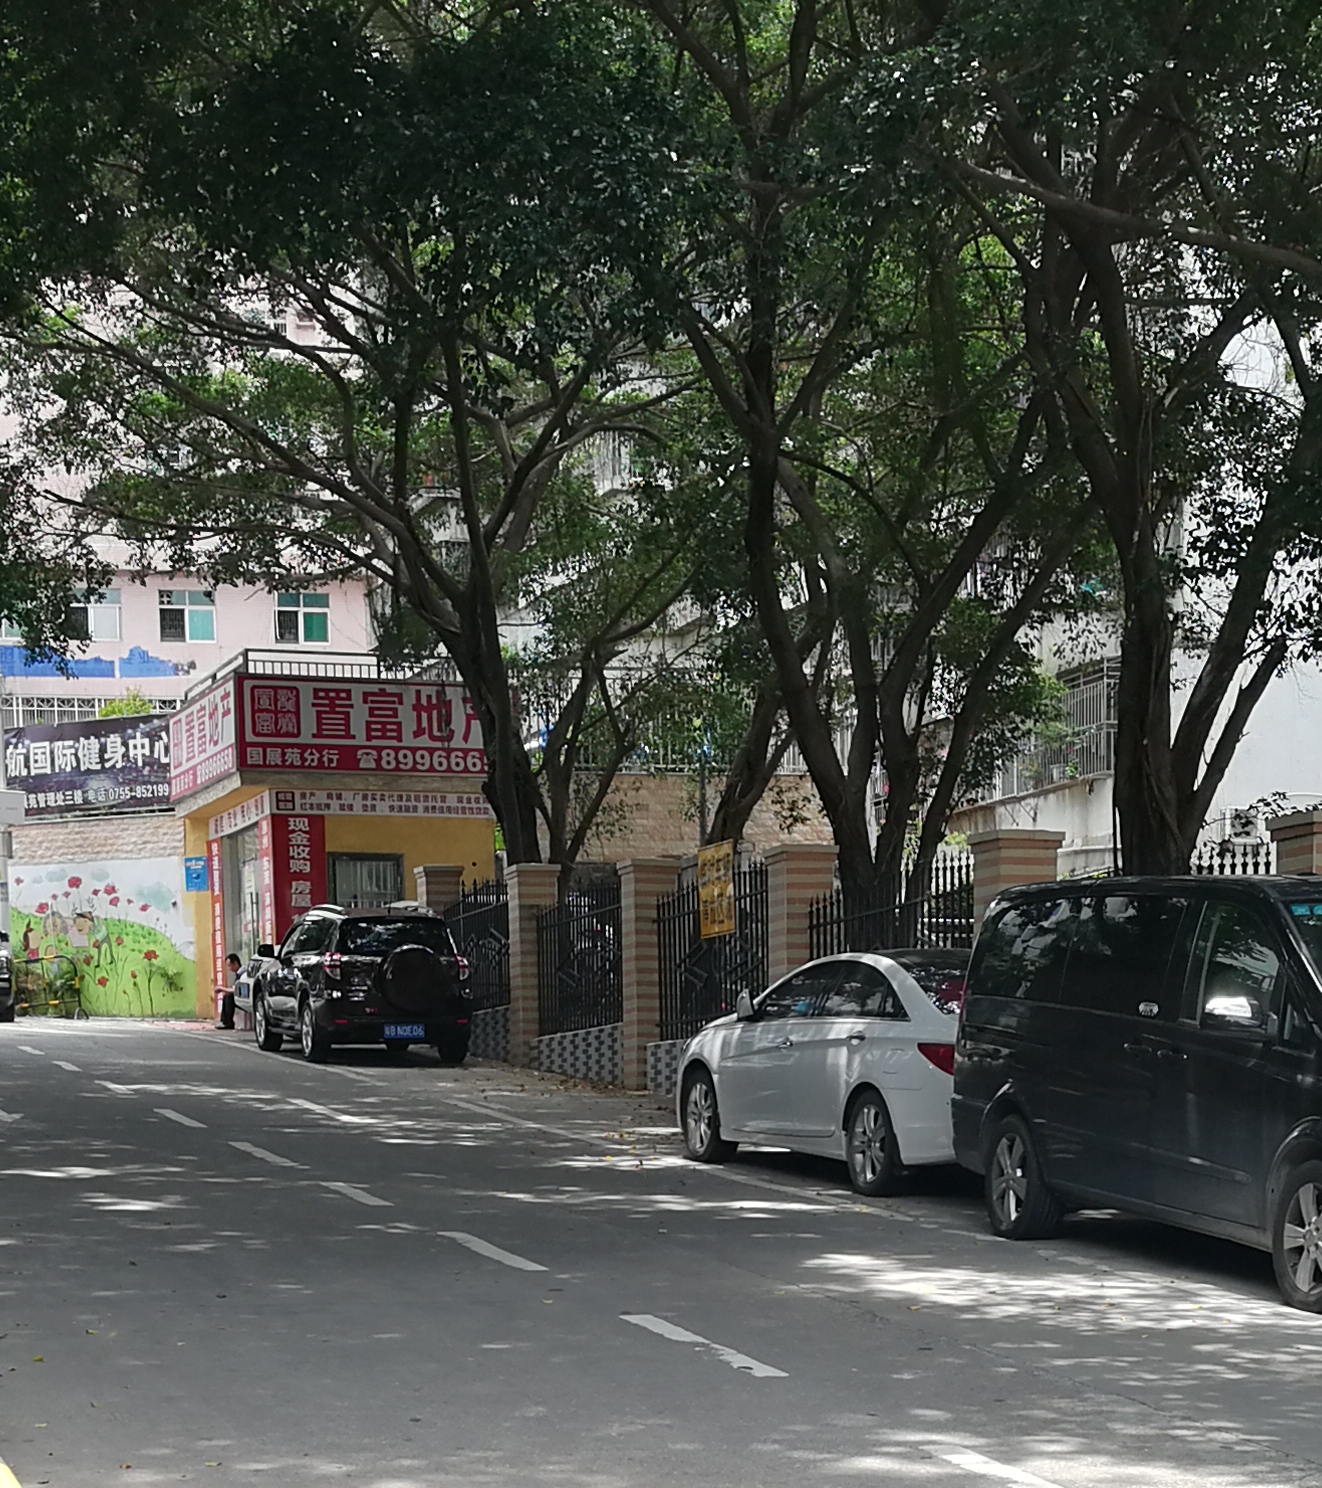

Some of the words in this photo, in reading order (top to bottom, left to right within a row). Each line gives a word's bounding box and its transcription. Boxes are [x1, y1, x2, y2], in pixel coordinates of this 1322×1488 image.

[246, 747, 340, 767] 国展苑分行
[288, 817, 310, 873] 现金收购
